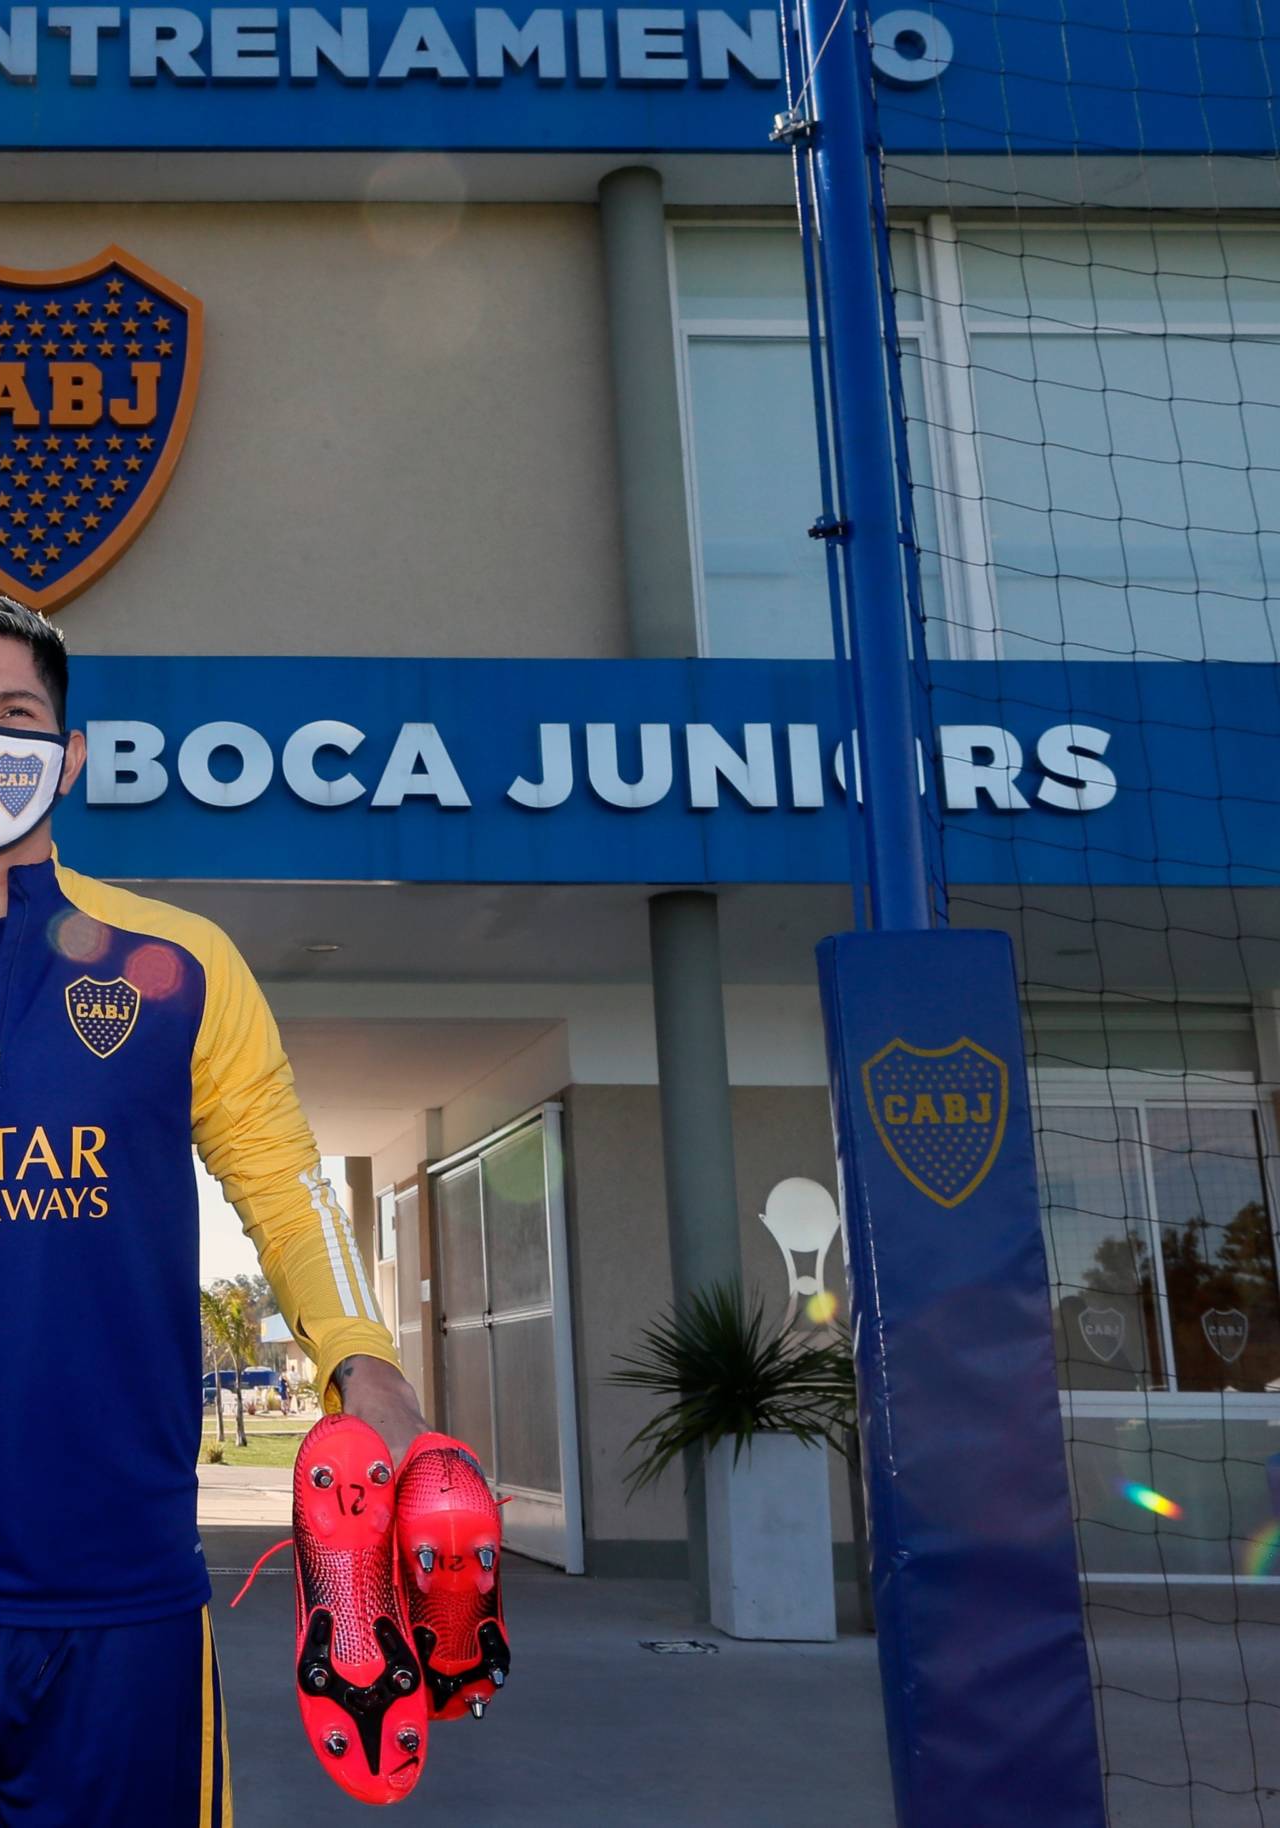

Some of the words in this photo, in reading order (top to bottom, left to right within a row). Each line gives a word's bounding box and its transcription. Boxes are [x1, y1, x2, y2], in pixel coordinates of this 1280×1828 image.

[86, 719, 474, 808] BOCA
[76, 1003, 131, 1021] CABJ
[885, 1093, 993, 1124] CABJ
